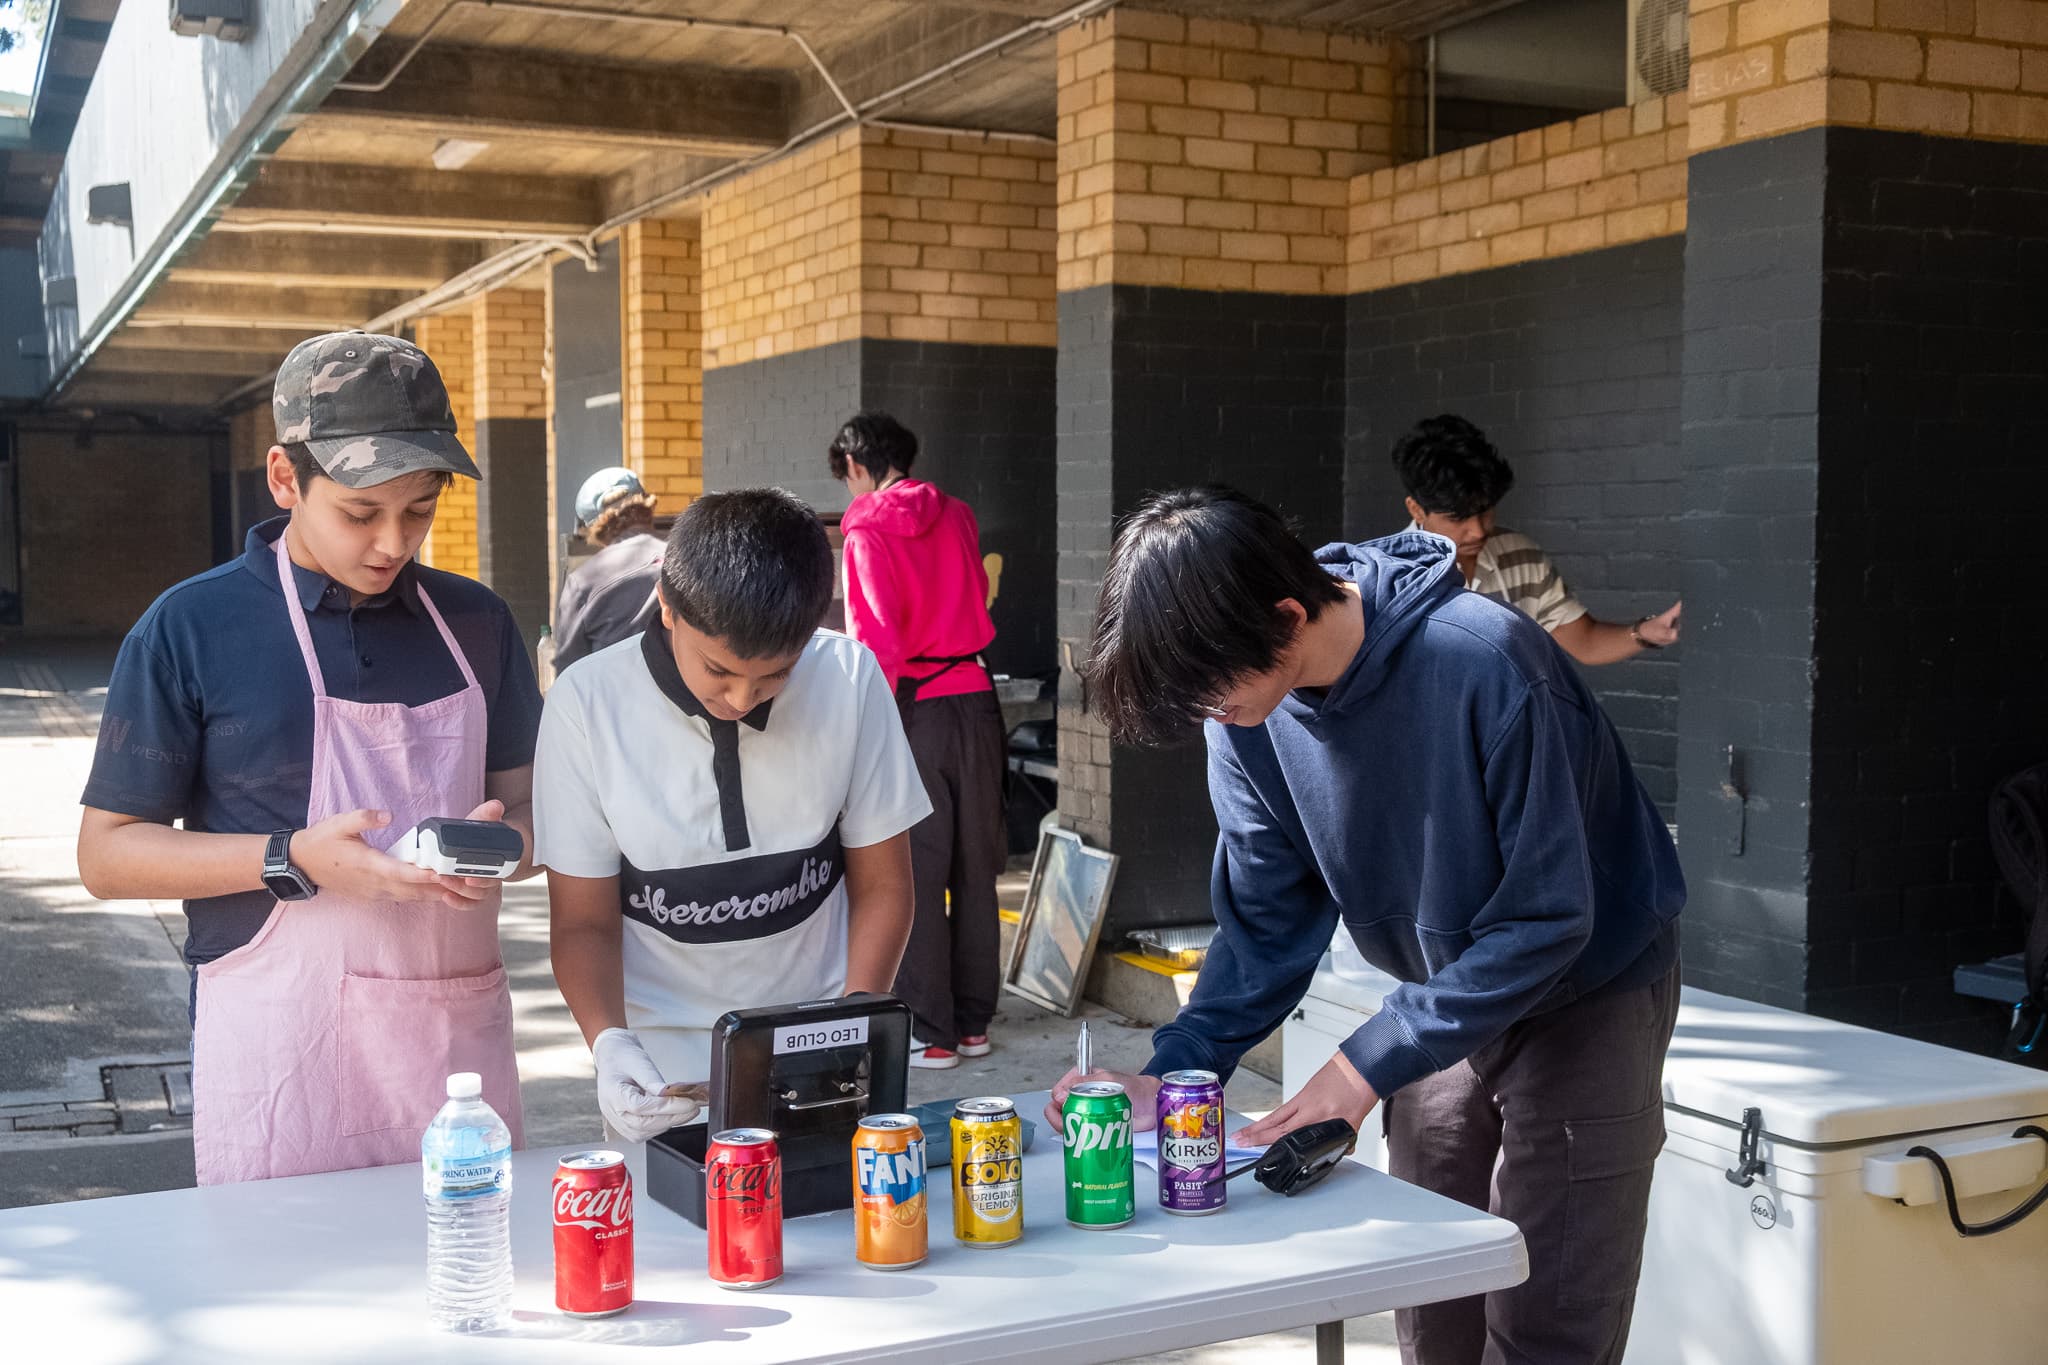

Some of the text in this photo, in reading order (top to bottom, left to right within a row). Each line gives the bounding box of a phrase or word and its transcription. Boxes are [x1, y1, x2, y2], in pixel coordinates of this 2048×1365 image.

[207, 720, 248, 738] ENDY
[131, 743, 193, 766] WEND
[629, 857, 832, 925] Abercrombie
[786, 1027, 859, 1049] LEO CLUB
[1166, 1142, 1218, 1158] KIRKS
[466, 1167, 492, 1176] WATER
[857, 1138, 927, 1189] FANT
[964, 1158, 1021, 1185] SOLO
[971, 1188, 1019, 1202] ORIGINAL
[979, 1199, 1017, 1211] LEMON
[595, 1227, 629, 1240] CLASSIC
